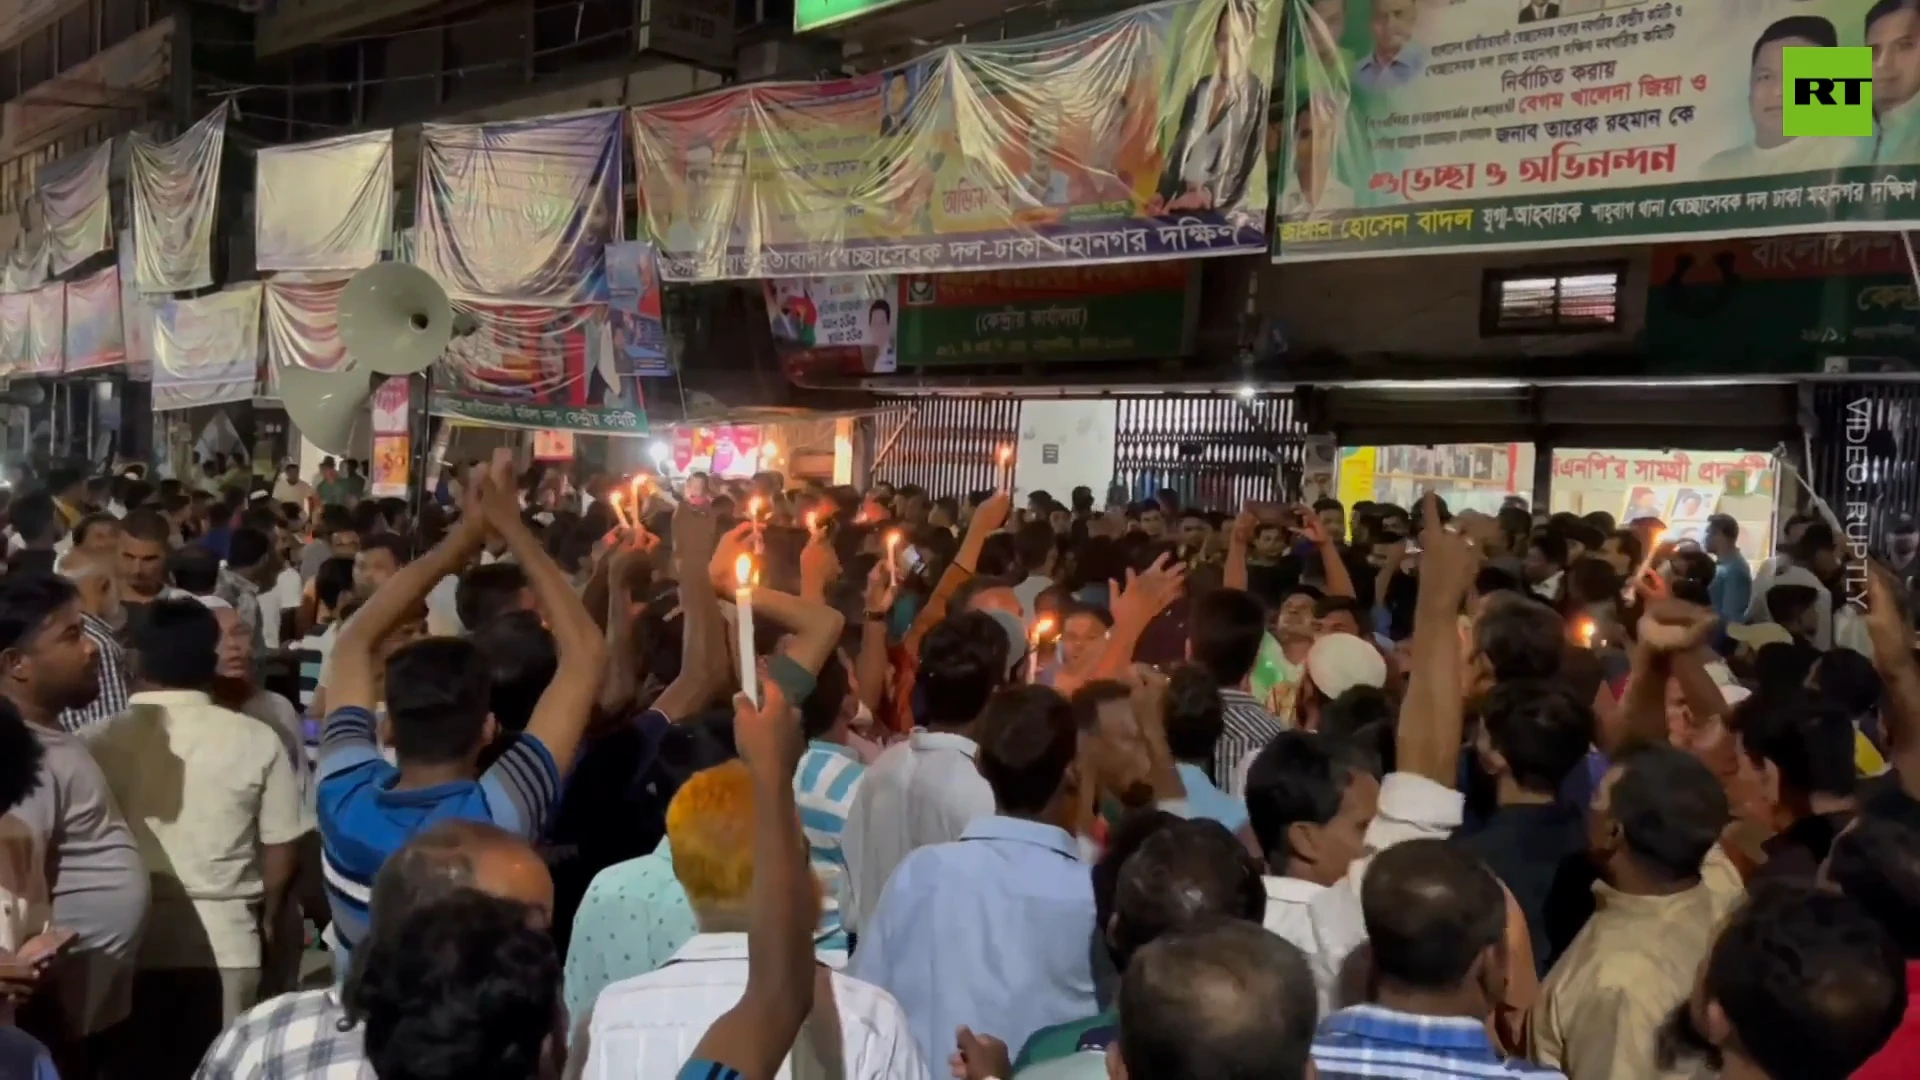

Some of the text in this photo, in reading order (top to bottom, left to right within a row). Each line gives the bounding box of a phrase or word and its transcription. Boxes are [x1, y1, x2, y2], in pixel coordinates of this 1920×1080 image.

[1501, 60, 1618, 93] নির্বাচিত করায়
[1518, 91, 1564, 113] বেগম
[1570, 84, 1632, 109] খালেদা
[1638, 74, 1682, 98] জিয়া
[1690, 75, 1707, 93] ও
[1495, 124, 1538, 145] জনাব
[1544, 115, 1600, 140] তারেক
[1605, 110, 1662, 134] রহমান
[1668, 104, 1697, 128] কে
[1368, 141, 1678, 200] শুভেচ্ছা ও অভিনন্দন
[1340, 212, 1408, 242] হোসেন
[1416, 208, 1475, 236] বাদল
[1746, 191, 1770, 211] দল
[1772, 186, 1803, 209] ঢাকা
[1807, 181, 1866, 207] মহানগর
[1157, 216, 1239, 250] দক্ষিণ
[602, 411, 638, 428] কমিটি
